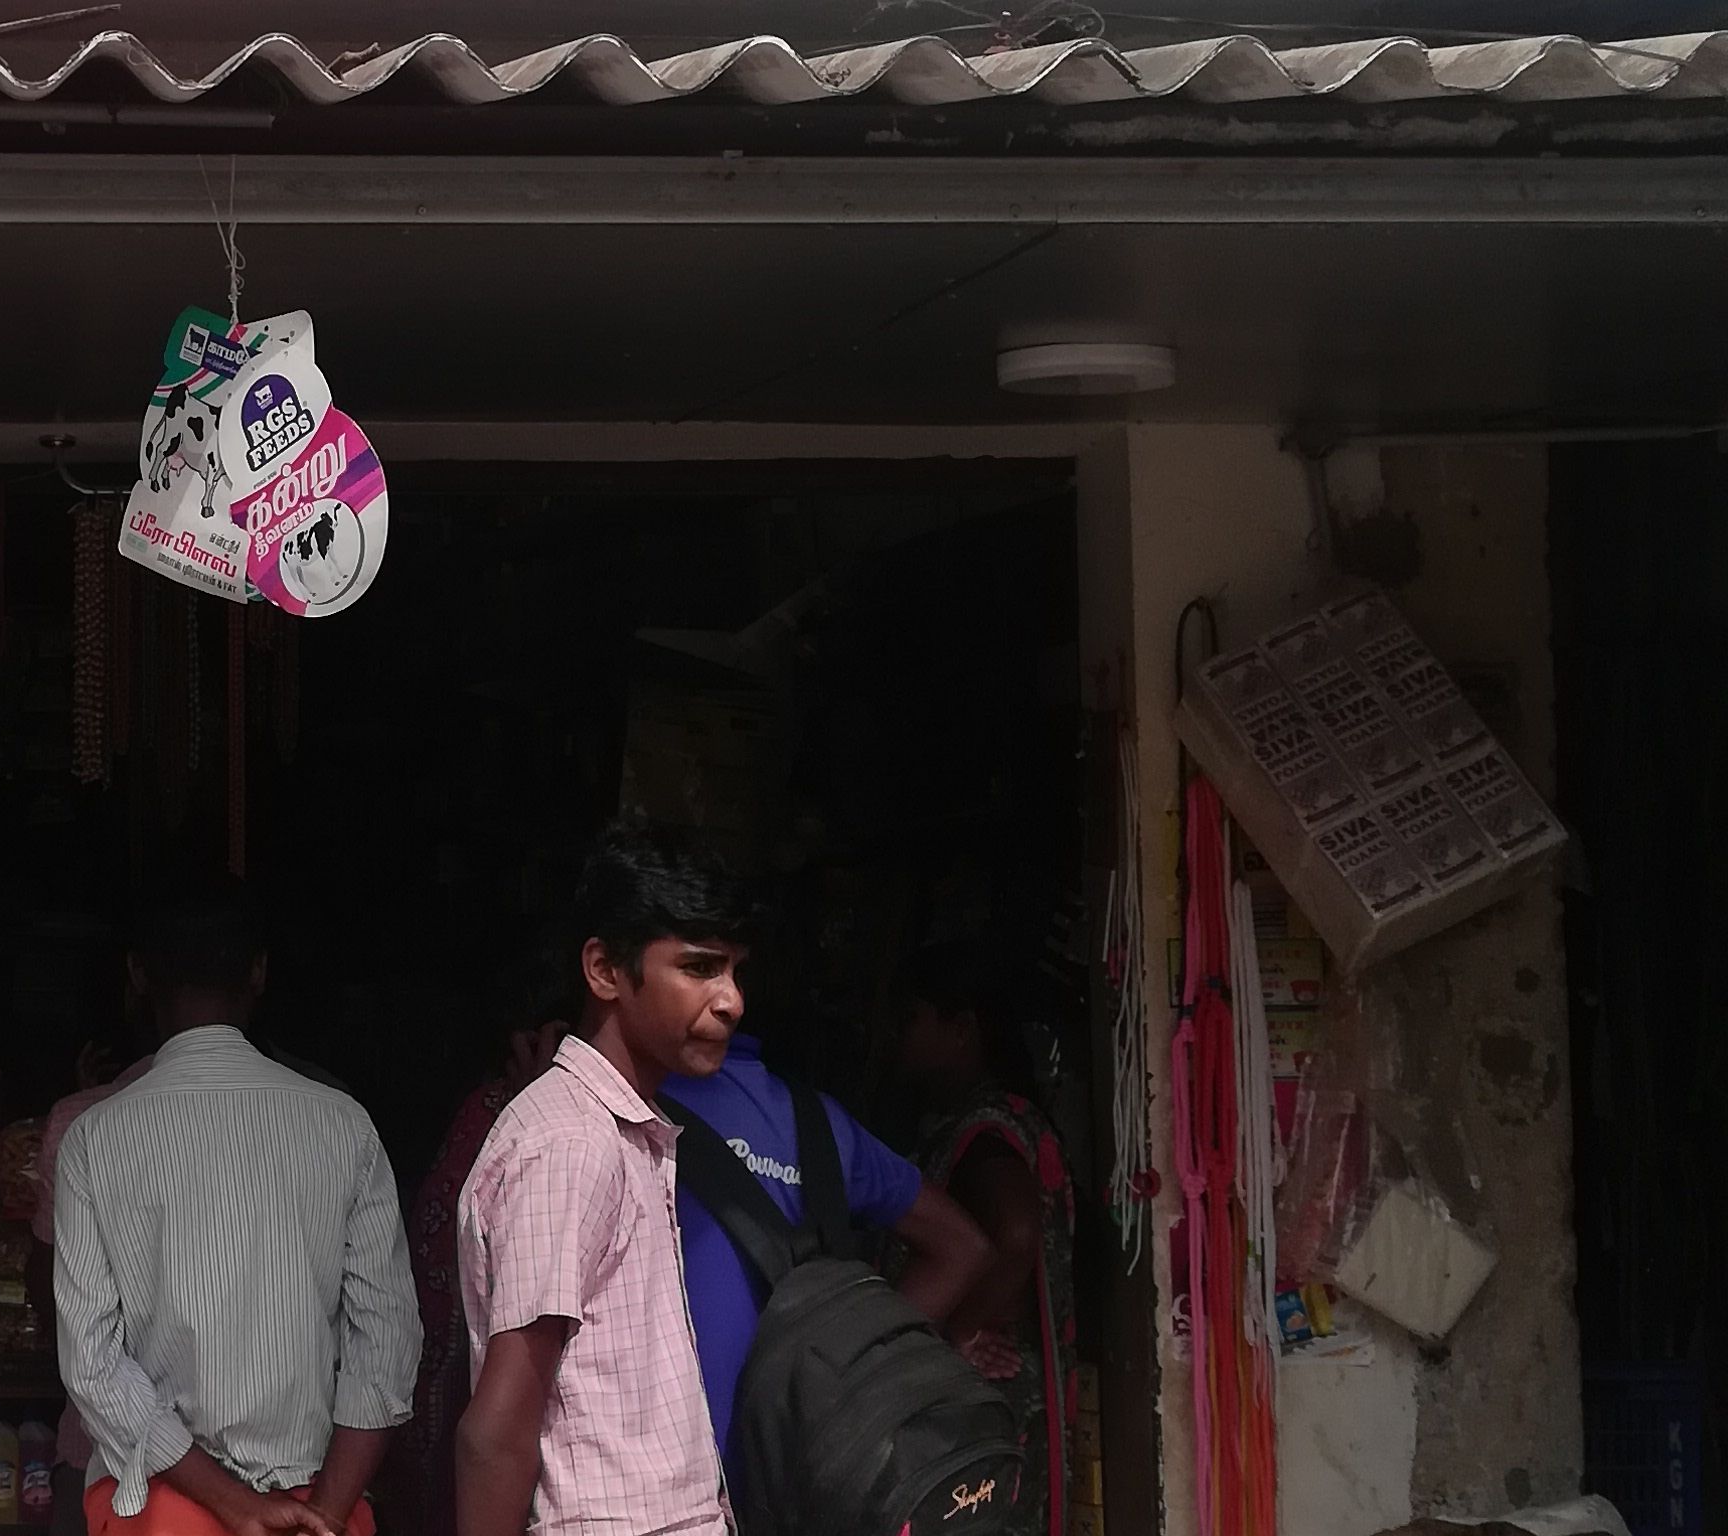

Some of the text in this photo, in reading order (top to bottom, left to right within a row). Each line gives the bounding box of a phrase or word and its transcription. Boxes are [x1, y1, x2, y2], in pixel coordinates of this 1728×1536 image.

[246, 395, 298, 448] RGS
[249, 413, 312, 469] FEEDS
[246, 432, 347, 536] கன்று
[255, 501, 314, 562] தீவனம்
[1386, 665, 1443, 699] SIVA
[1321, 695, 1378, 727] SIVA
[1254, 728, 1313, 761] SIVA
[1446, 753, 1505, 790] SIVA
[1380, 784, 1437, 819] SIVA
[1318, 815, 1376, 852] SIVA
